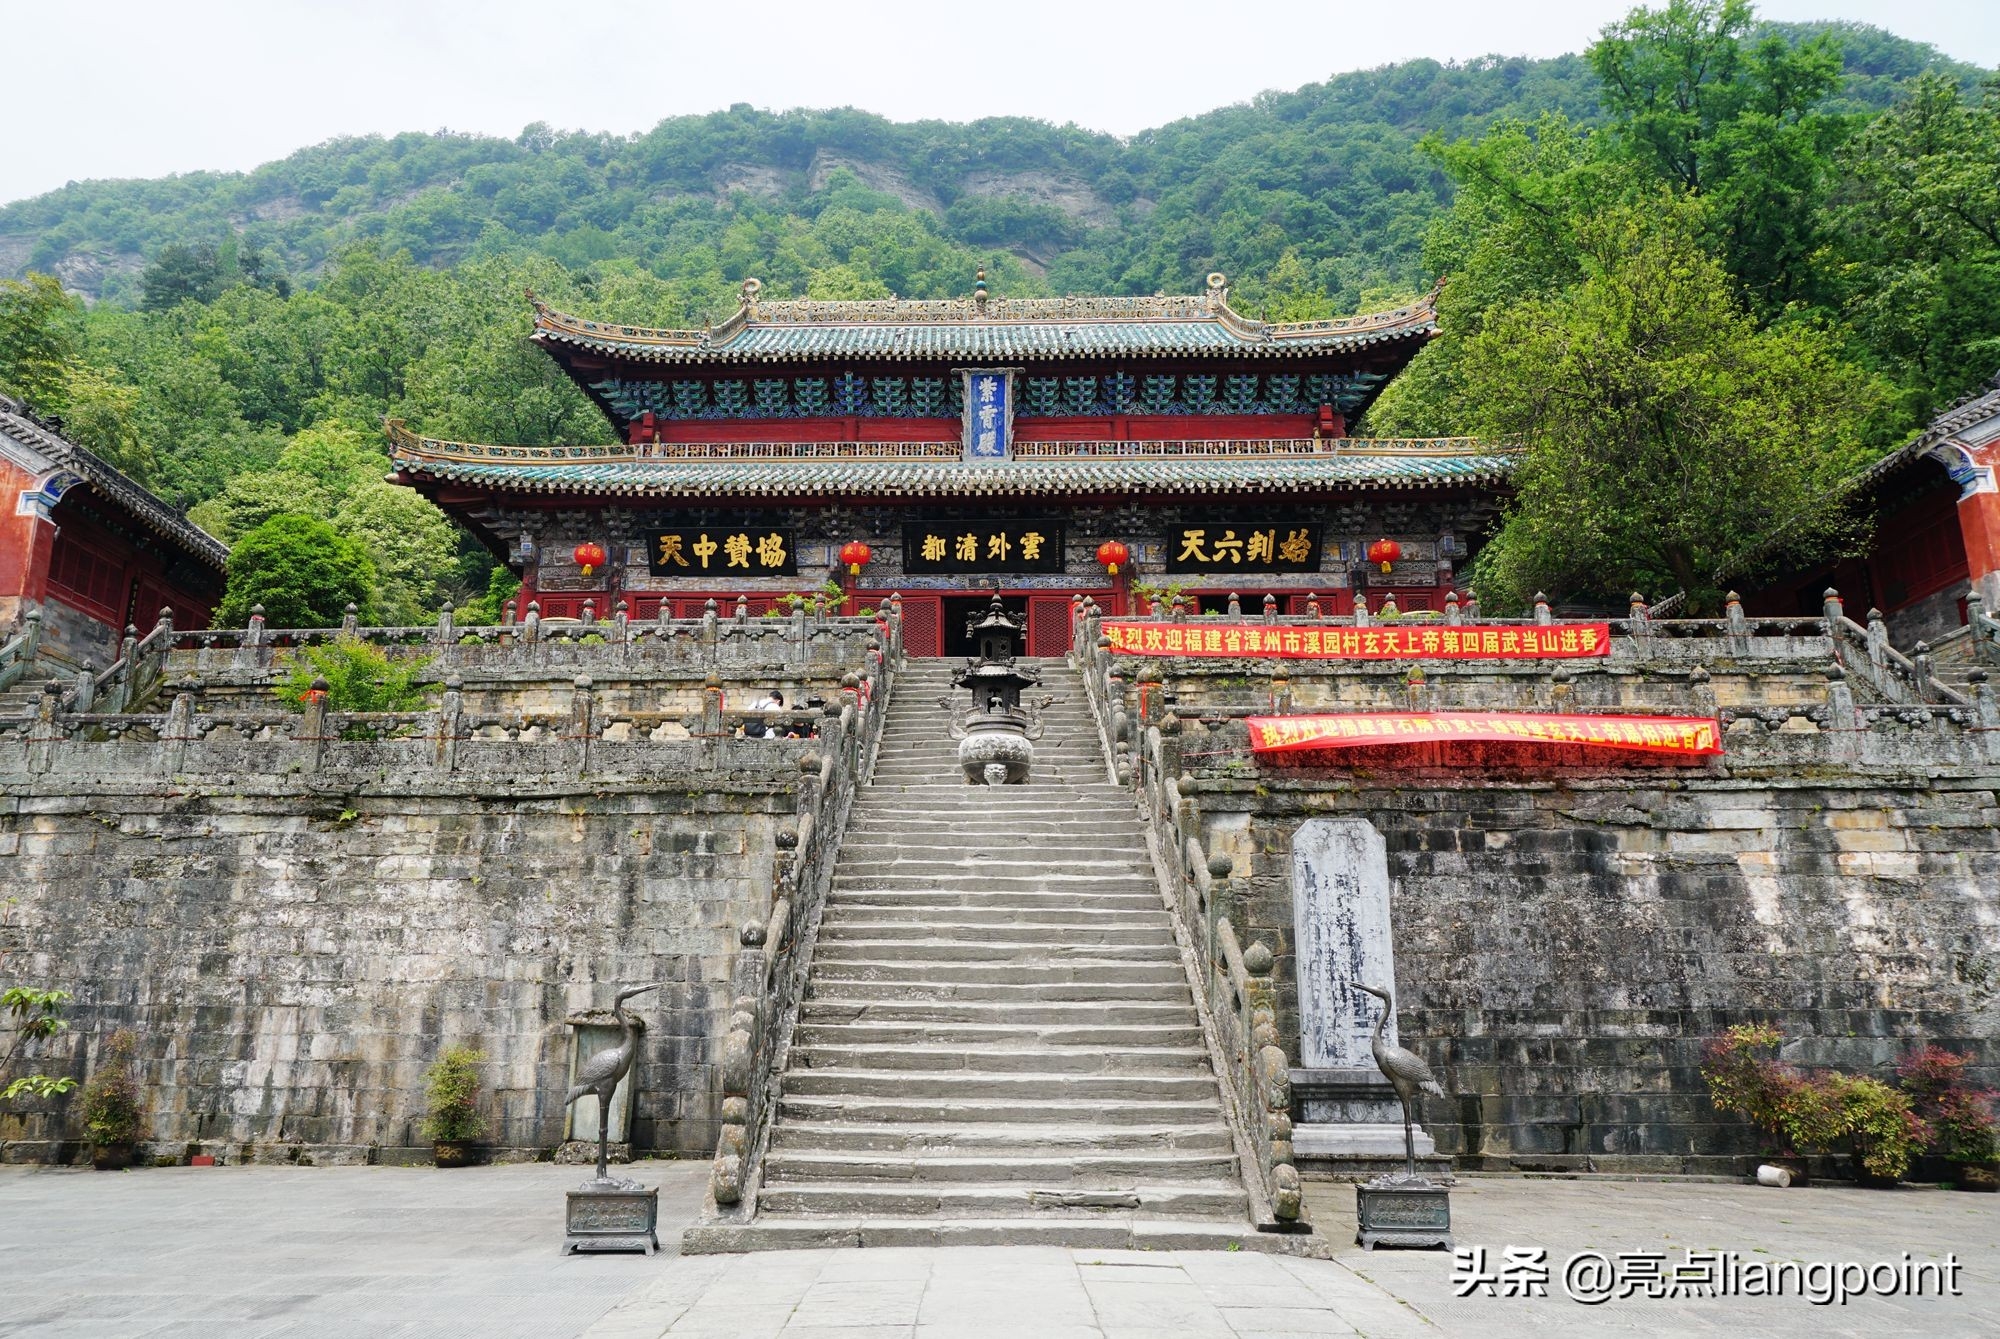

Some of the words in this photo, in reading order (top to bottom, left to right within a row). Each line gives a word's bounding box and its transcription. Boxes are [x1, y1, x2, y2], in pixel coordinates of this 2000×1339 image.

[1105, 627, 1598, 655] 热烈欢迎福建省漳州市溪园村玄天上帝第四届武当山进香
